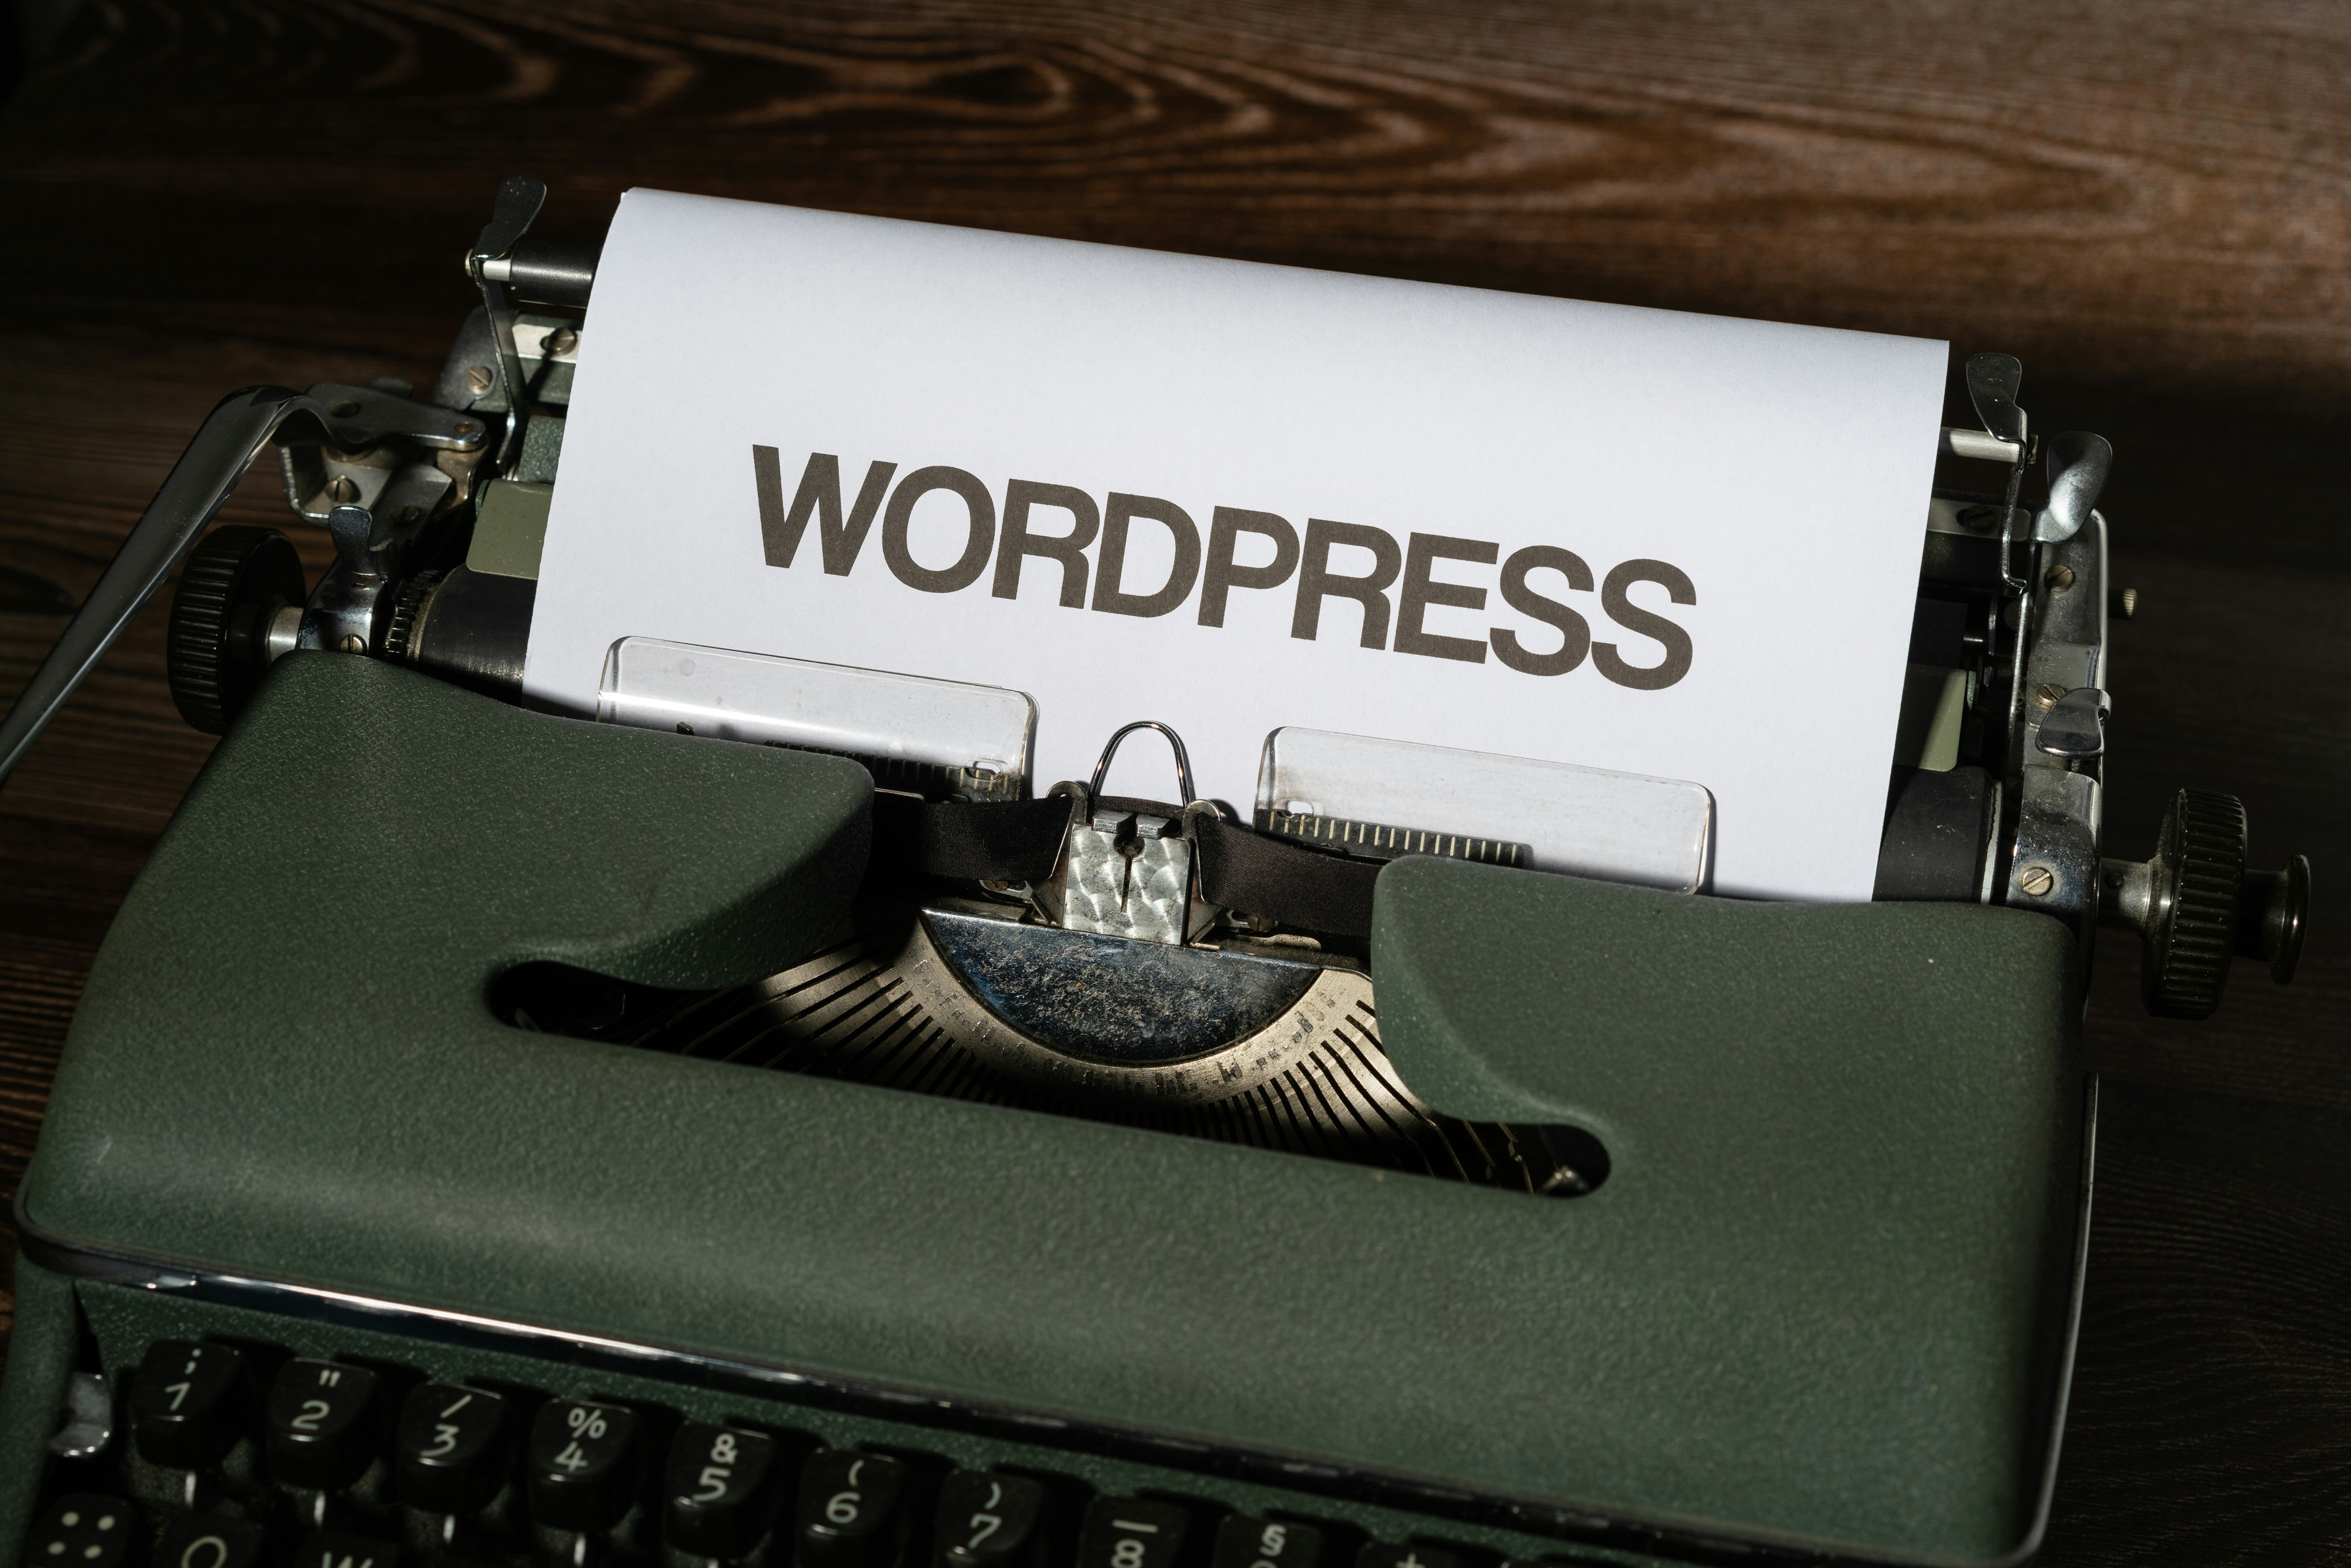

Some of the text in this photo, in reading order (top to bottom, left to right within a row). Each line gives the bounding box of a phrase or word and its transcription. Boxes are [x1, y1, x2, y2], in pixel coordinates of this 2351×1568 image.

[753, 444, 1696, 690] WORDPRESS
[165, 1382, 190, 1410] 1
[291, 1400, 330, 1430] 2
[567, 1407, 607, 1439] %
[420, 1423, 459, 1457] 3
[710, 1433, 737, 1464] &
[554, 1441, 587, 1473] 4
[693, 1466, 731, 1502] 5
[826, 1492, 860, 1524] 6
[969, 1513, 1002, 1549] 7
[1111, 1538, 1145, 1568] 8
